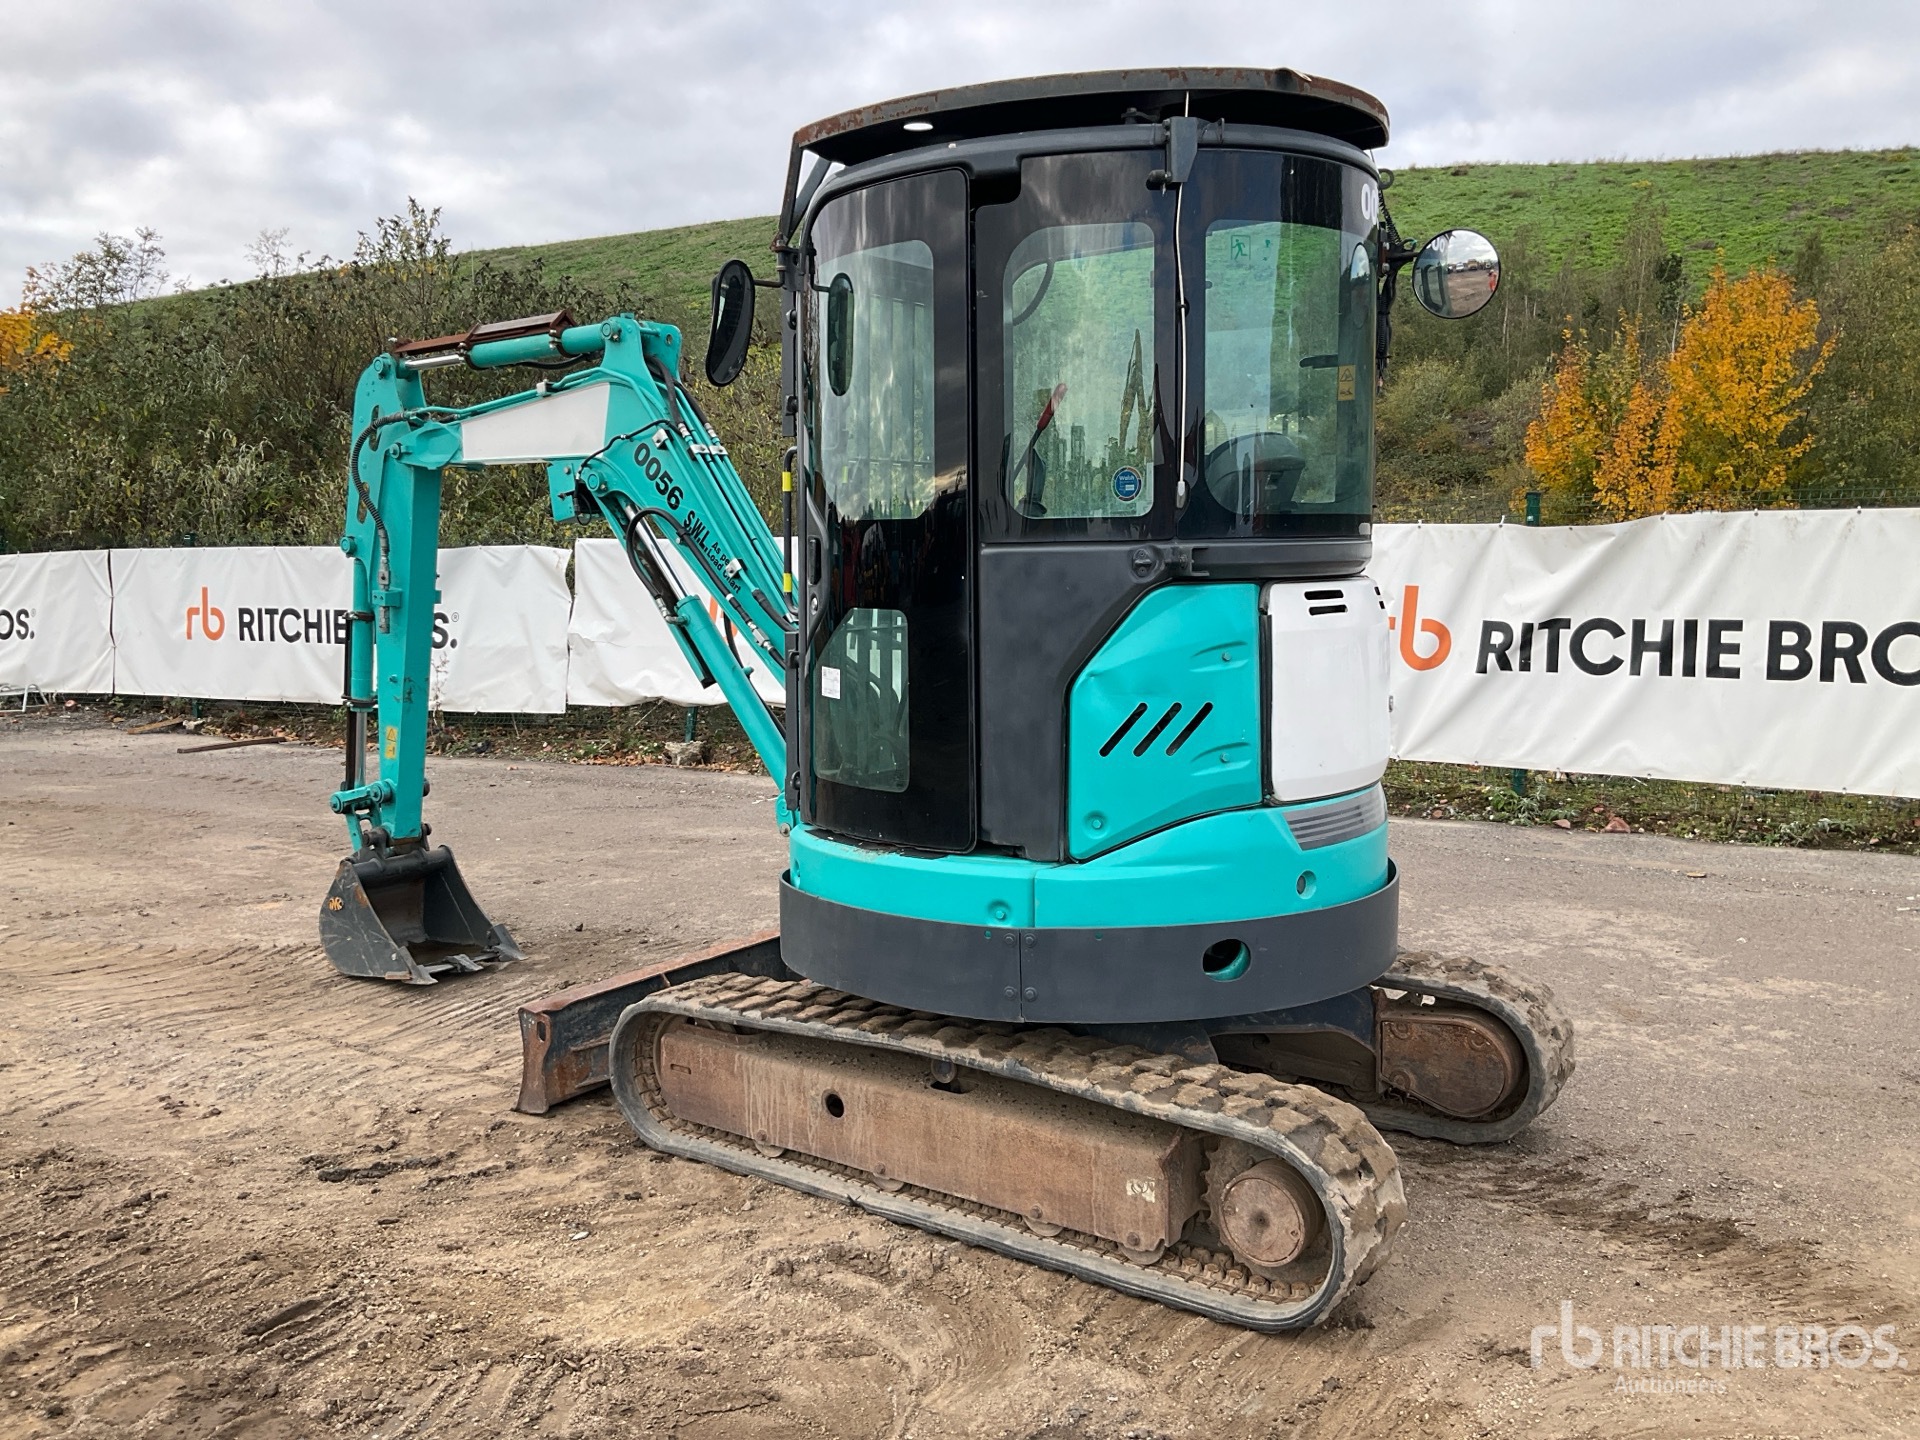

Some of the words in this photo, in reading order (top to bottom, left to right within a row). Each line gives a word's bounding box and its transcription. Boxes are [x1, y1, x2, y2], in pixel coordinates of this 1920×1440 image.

[633, 442, 684, 511] 0056
[706, 548, 724, 571] Load
[711, 541, 722, 555] As
[186, 586, 225, 641] rb
[238, 607, 347, 645] RITCHIE
[1388, 585, 1452, 672] b
[1474, 617, 1744, 680] RITCHIE
